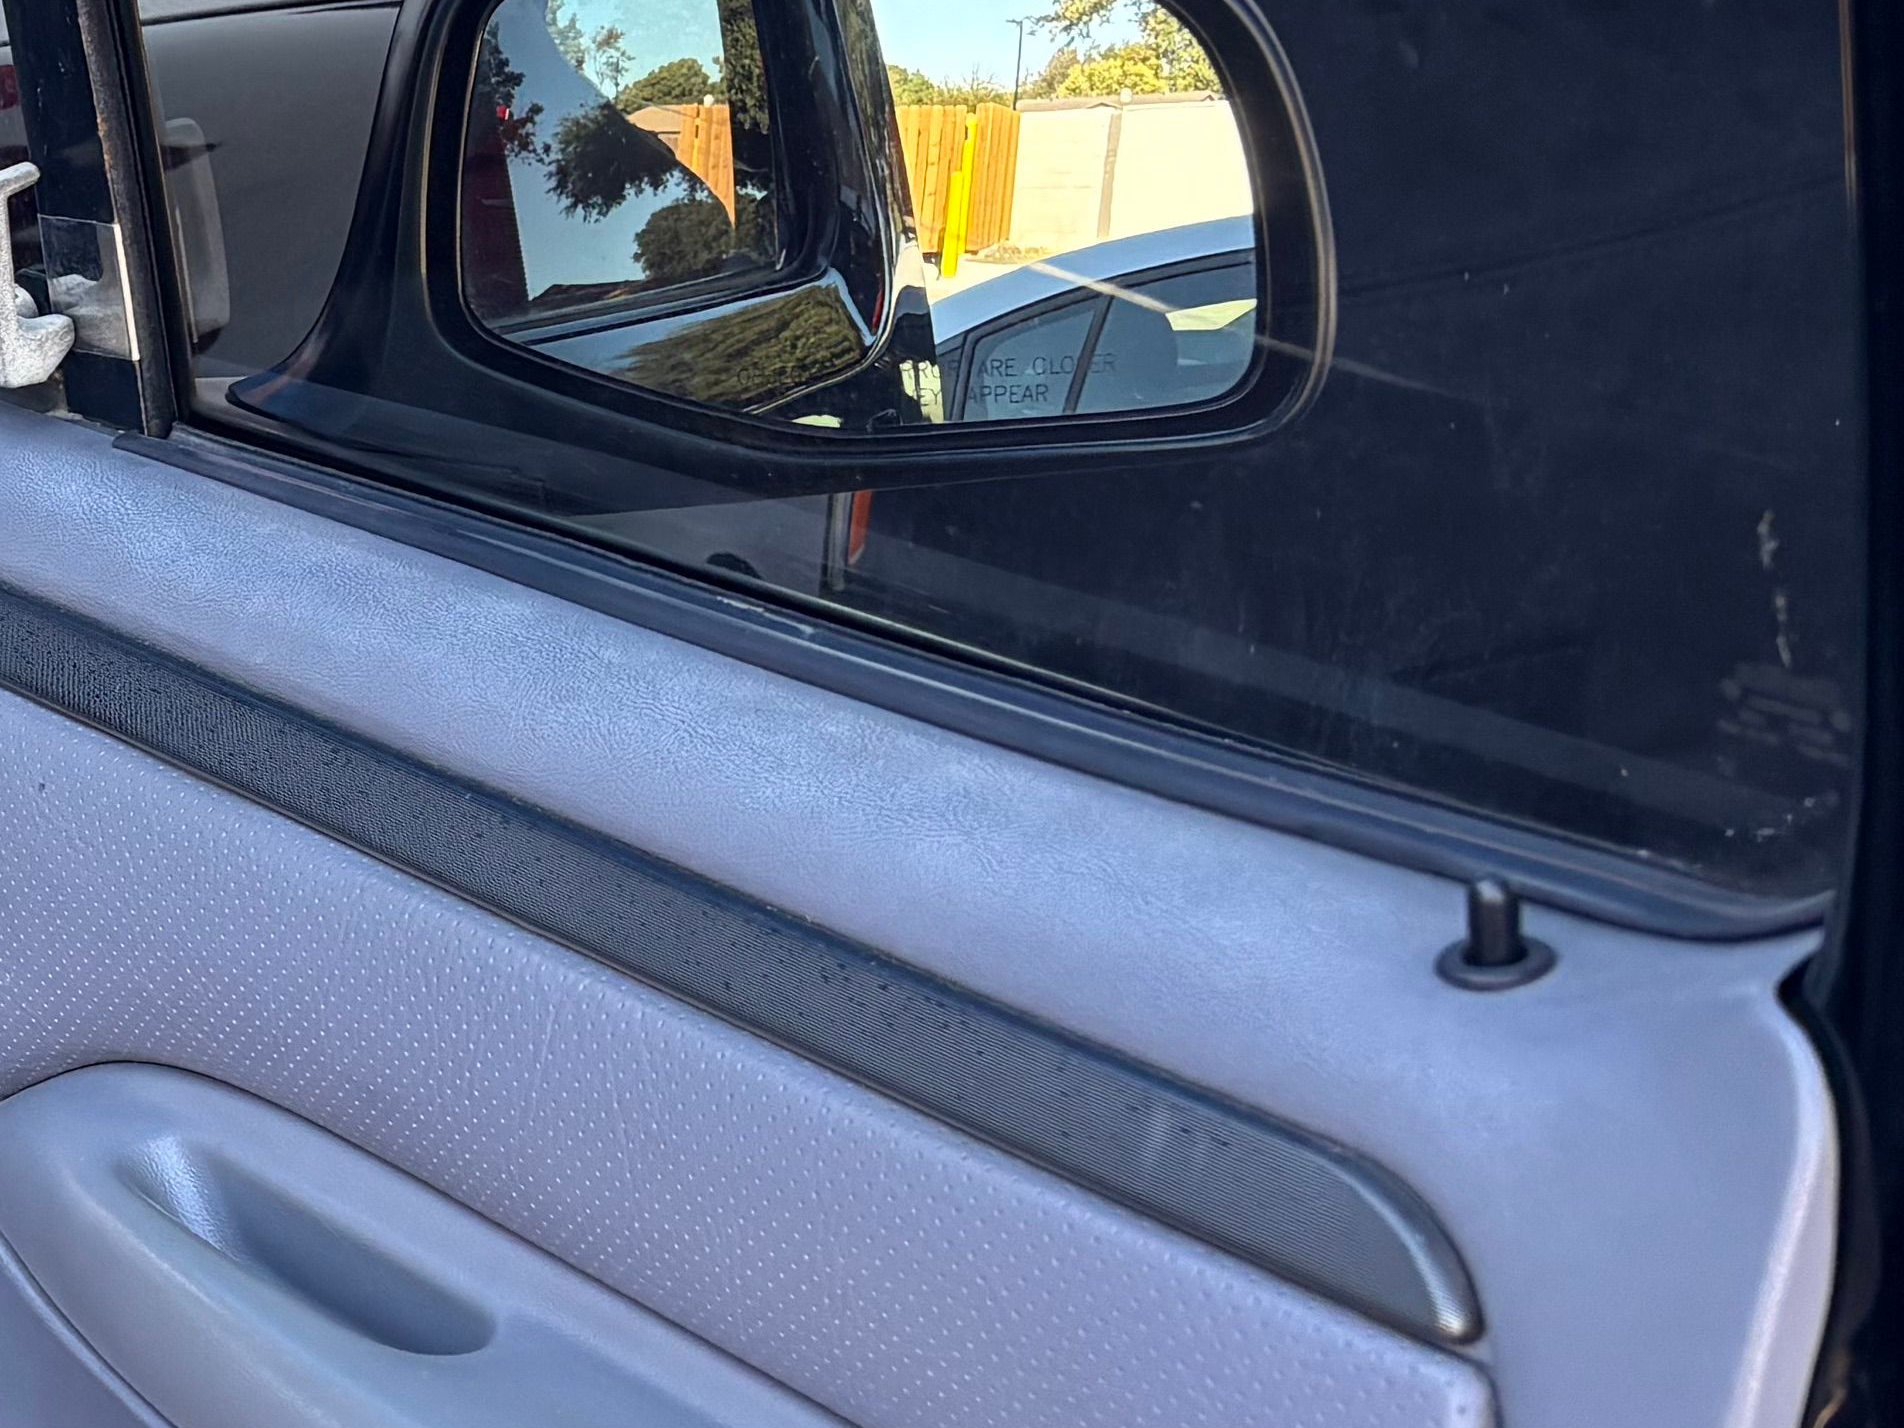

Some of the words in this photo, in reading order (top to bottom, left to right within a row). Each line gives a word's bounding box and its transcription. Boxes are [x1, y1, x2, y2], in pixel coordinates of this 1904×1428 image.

[979, 357, 1017, 379] ARE
[1031, 352, 1120, 376] CLOER
[967, 383, 1049, 406] APPEAR
